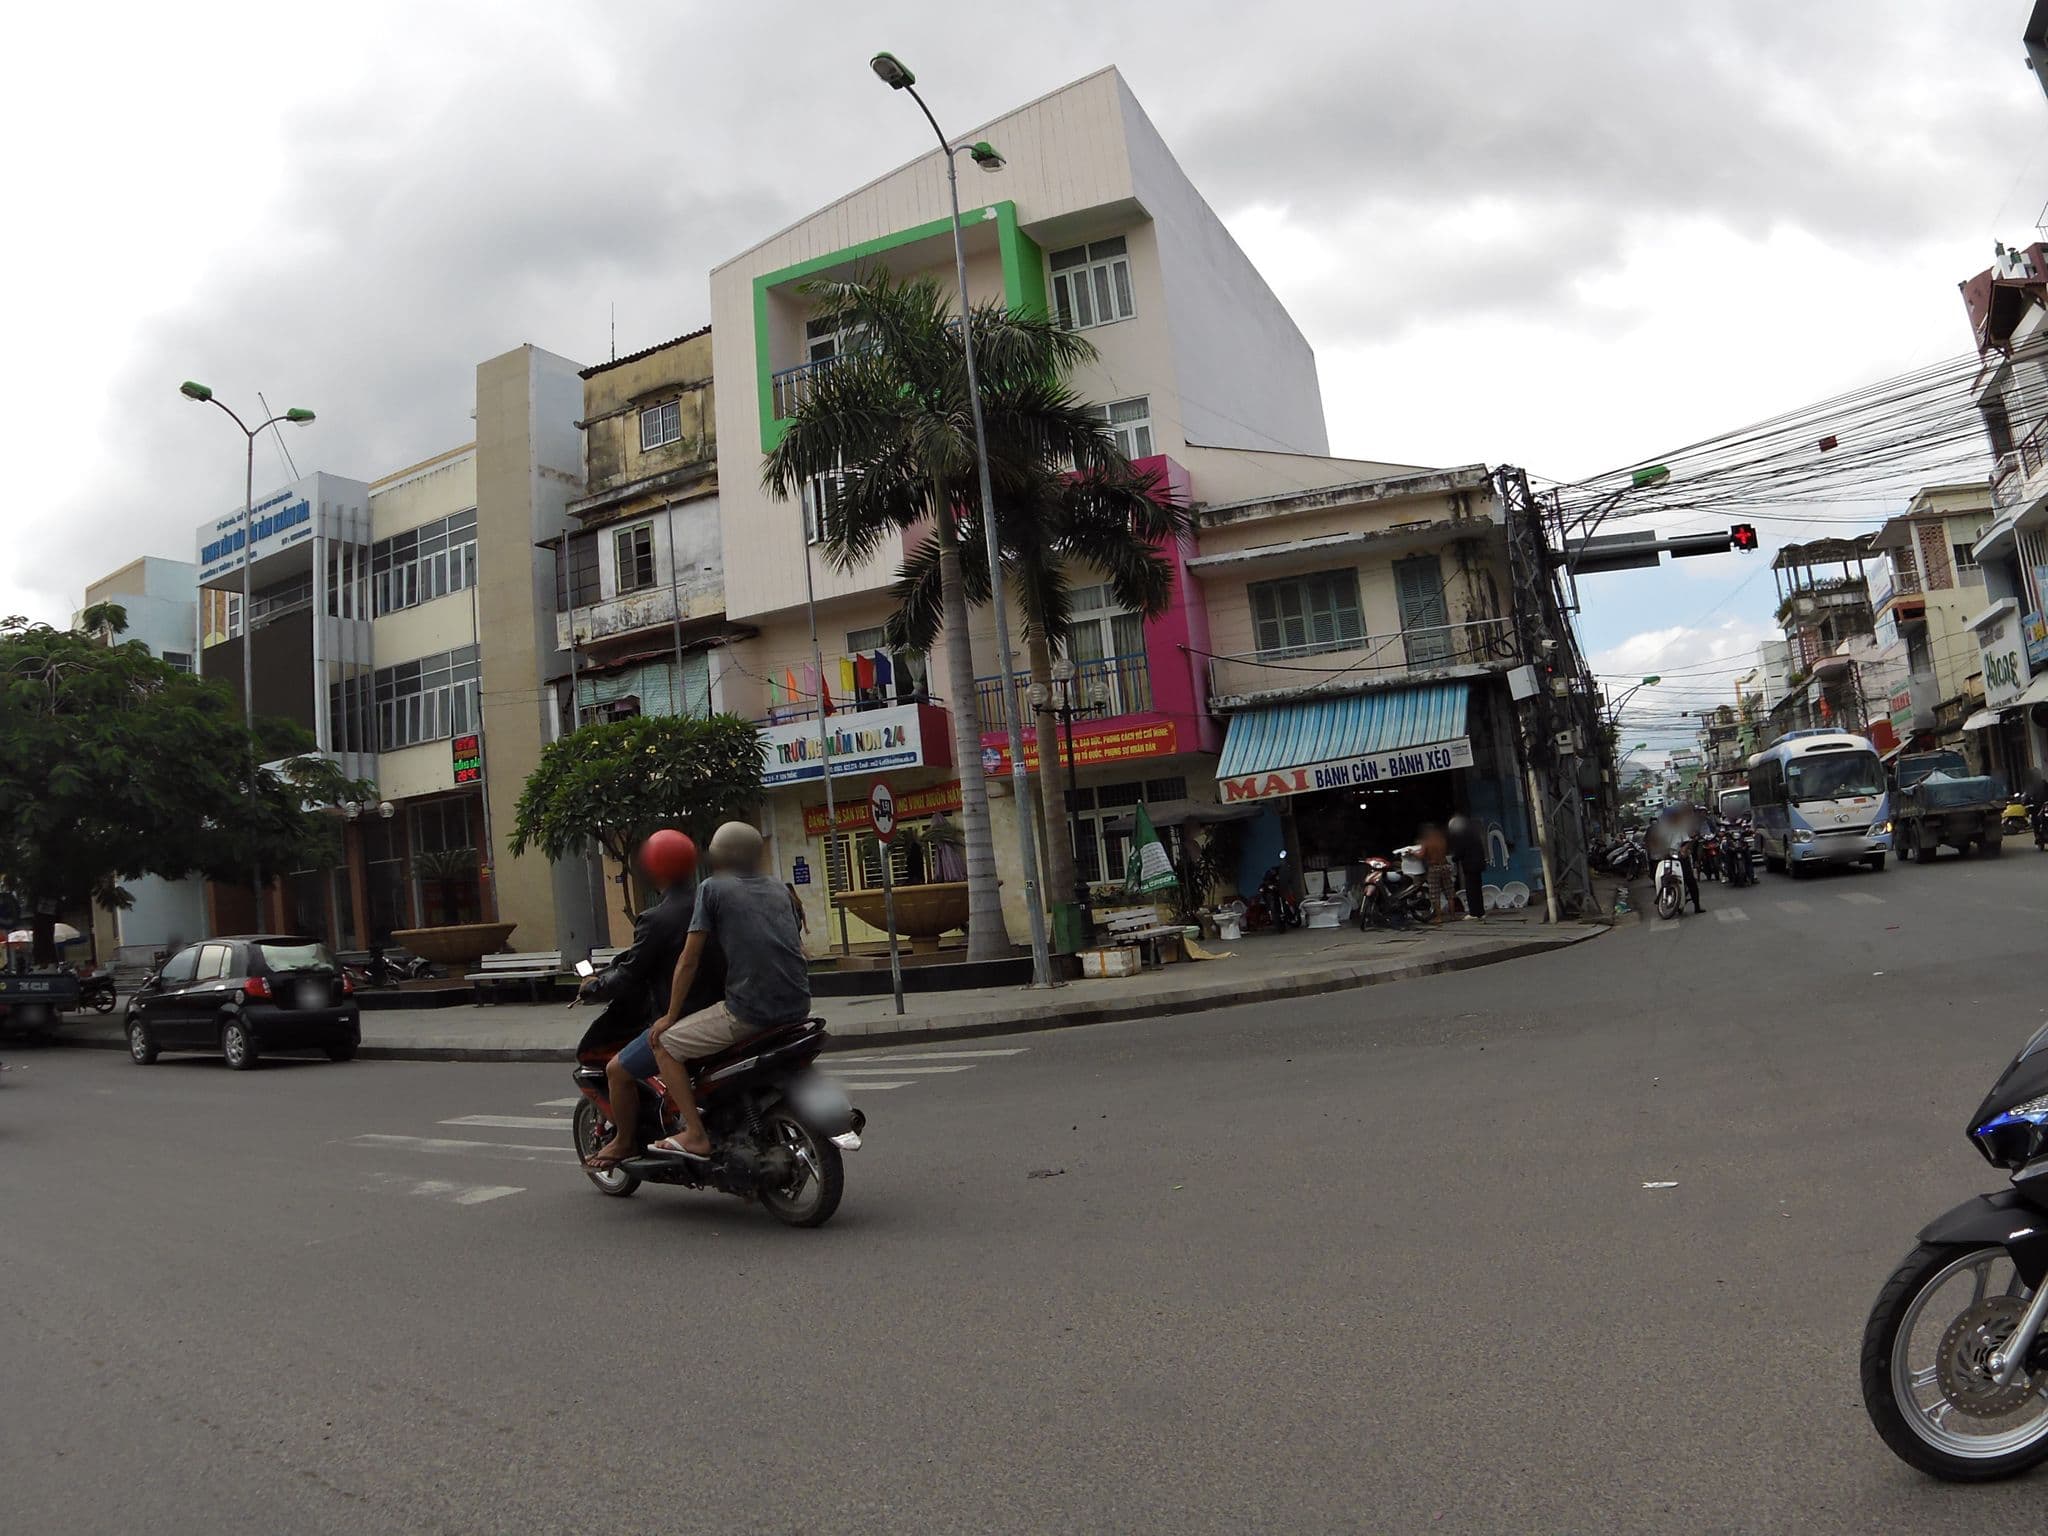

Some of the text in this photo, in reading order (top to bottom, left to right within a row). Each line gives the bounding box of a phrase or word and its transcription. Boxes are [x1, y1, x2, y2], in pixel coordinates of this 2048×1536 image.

[776, 725, 906, 764] TRƯỜNG MẦM NON 2/4
[1223, 769, 1310, 801] MAI
[1315, 763, 1351, 789] BÁNH
[1352, 759, 1379, 783] CĂN
[1389, 752, 1426, 778] BÁNH
[1427, 746, 1452, 771] XÈO
